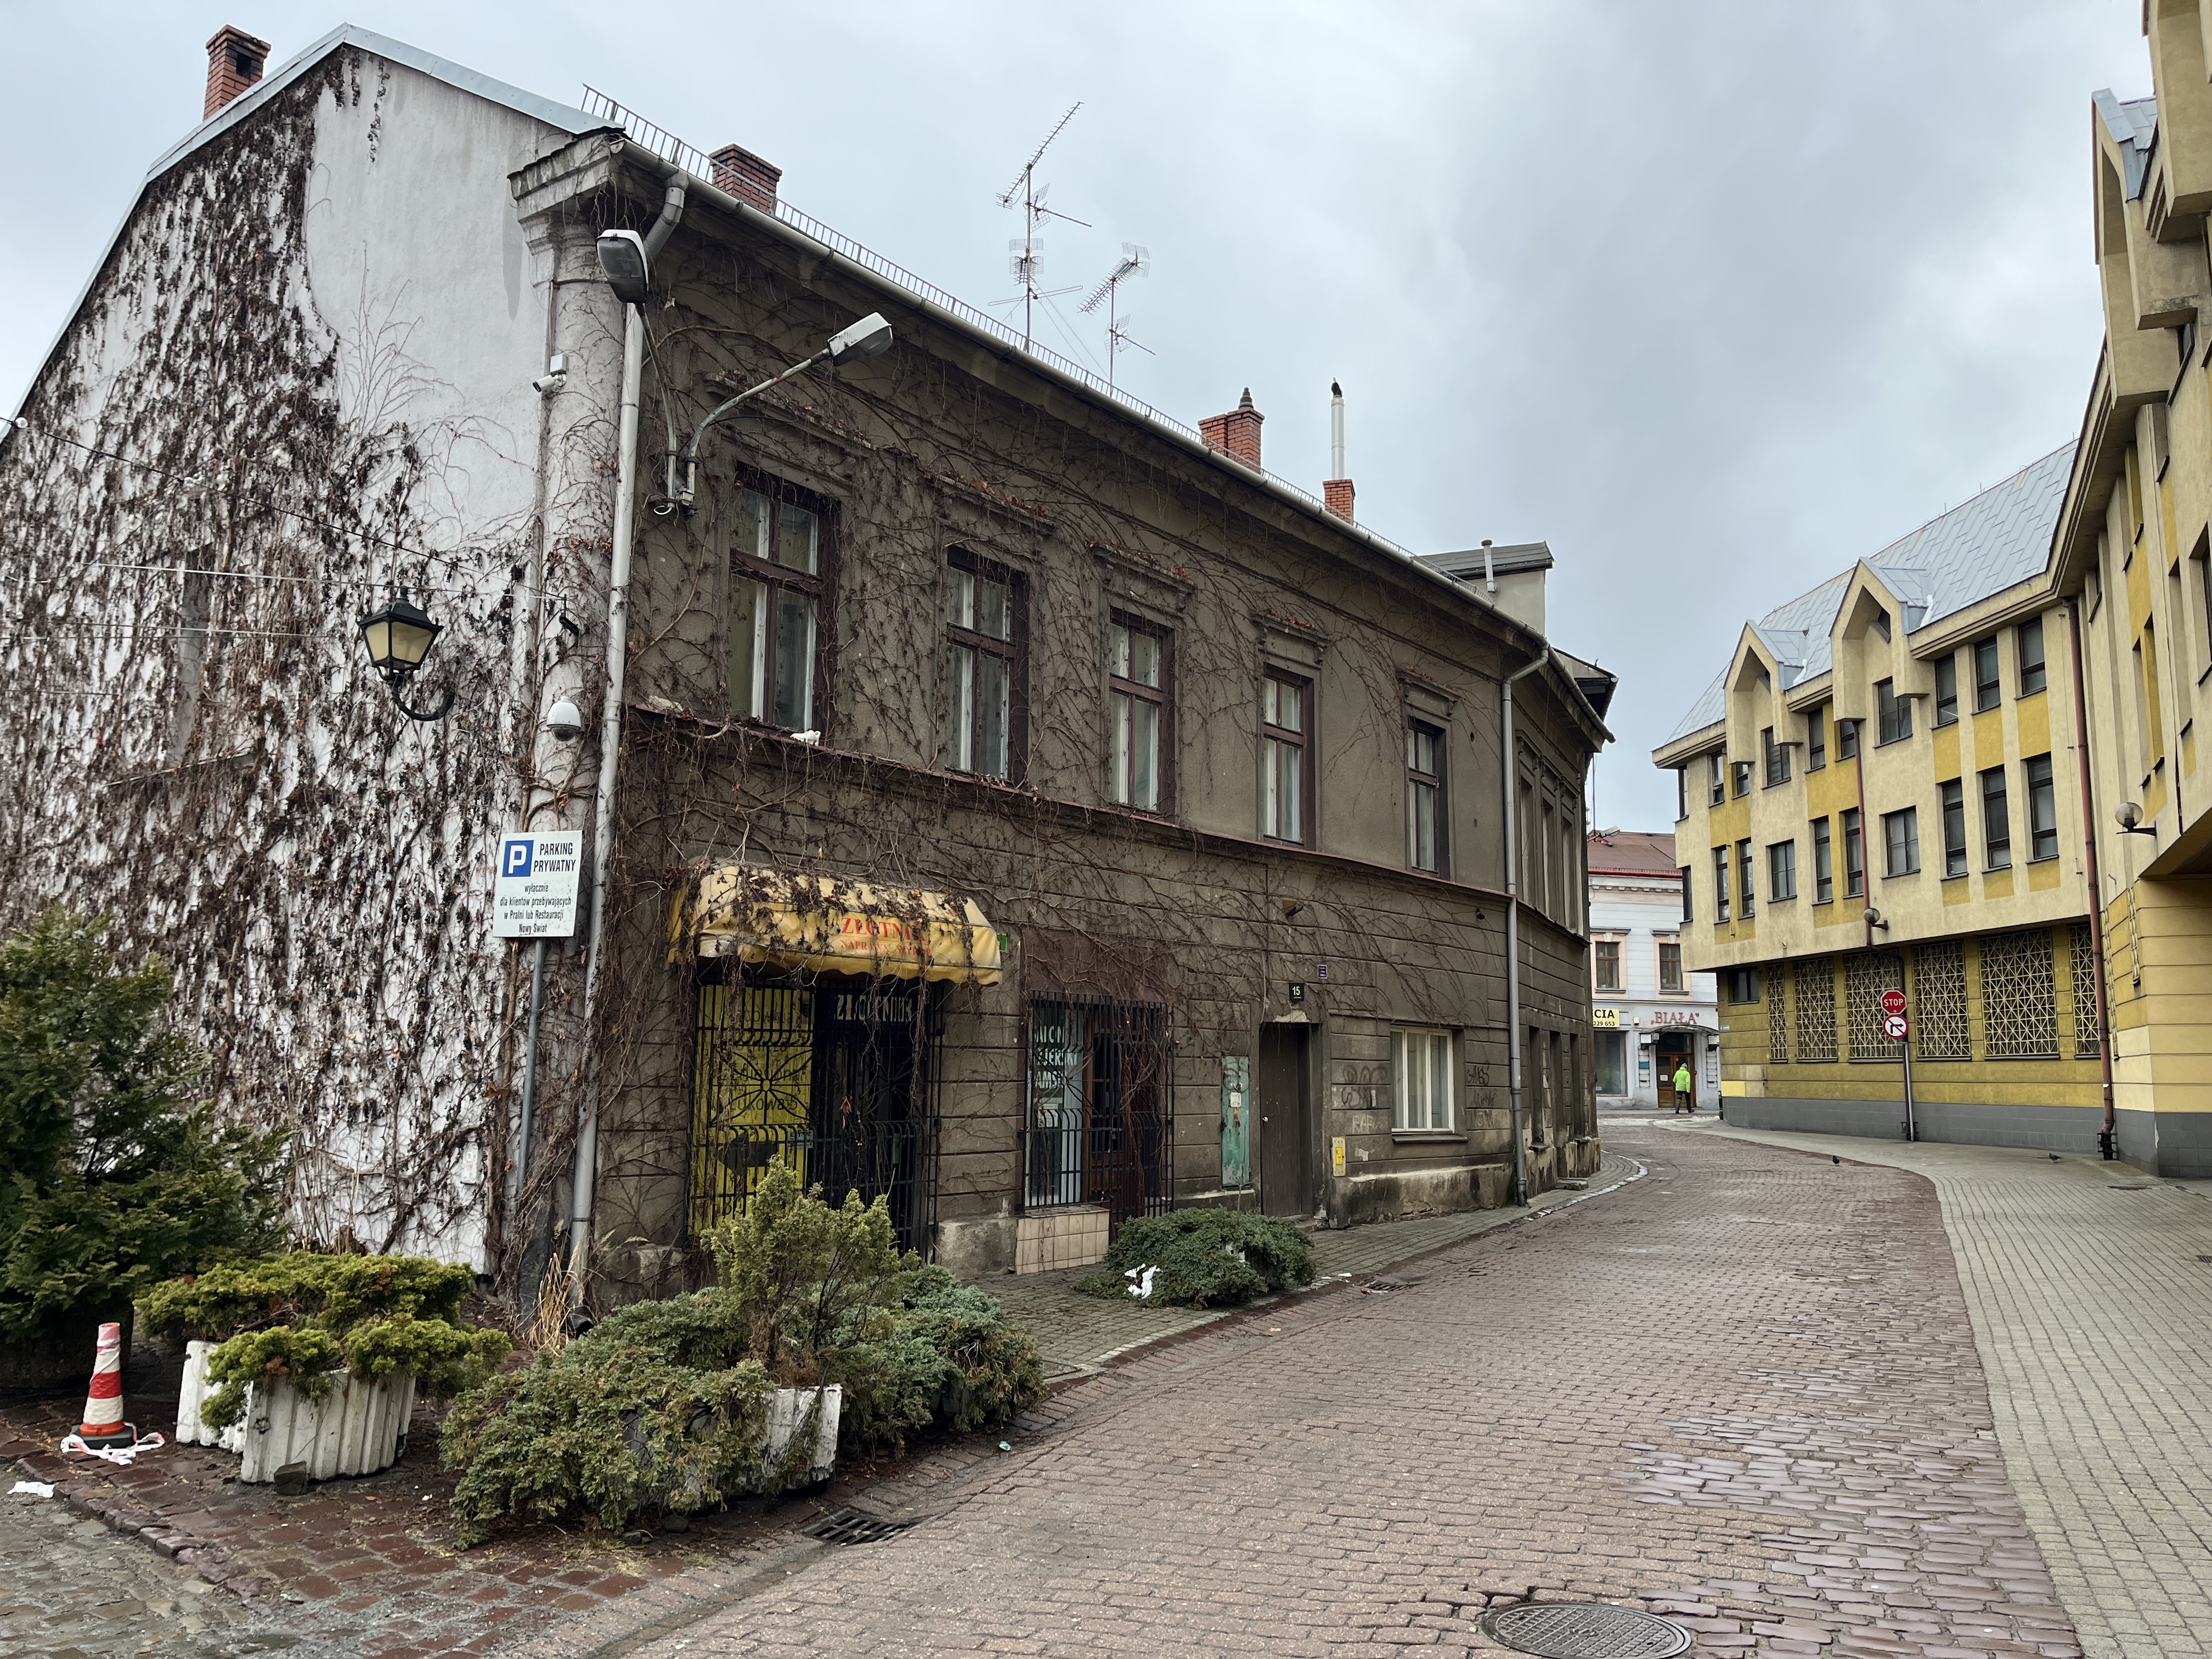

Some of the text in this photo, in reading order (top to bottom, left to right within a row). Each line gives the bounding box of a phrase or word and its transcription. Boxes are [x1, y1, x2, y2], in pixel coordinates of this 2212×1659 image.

[539, 843, 573, 856] PARKING
[508, 845, 527, 873] P
[533, 859, 575, 872] PRYWATNY
[524, 883, 549, 895] wyłącznie
[509, 896, 530, 906] klientów
[532, 896, 571, 908] przebywających
[510, 910, 524, 919] Pralni
[535, 910, 564, 921] Restauracji
[518, 920, 548, 934] Nowy Świat
[840, 917, 927, 941] ZŁOTNI
[1292, 986, 1300, 996] 15
[1883, 998, 1904, 1007] STOP
[1593, 1009, 1615, 1019] CIA
